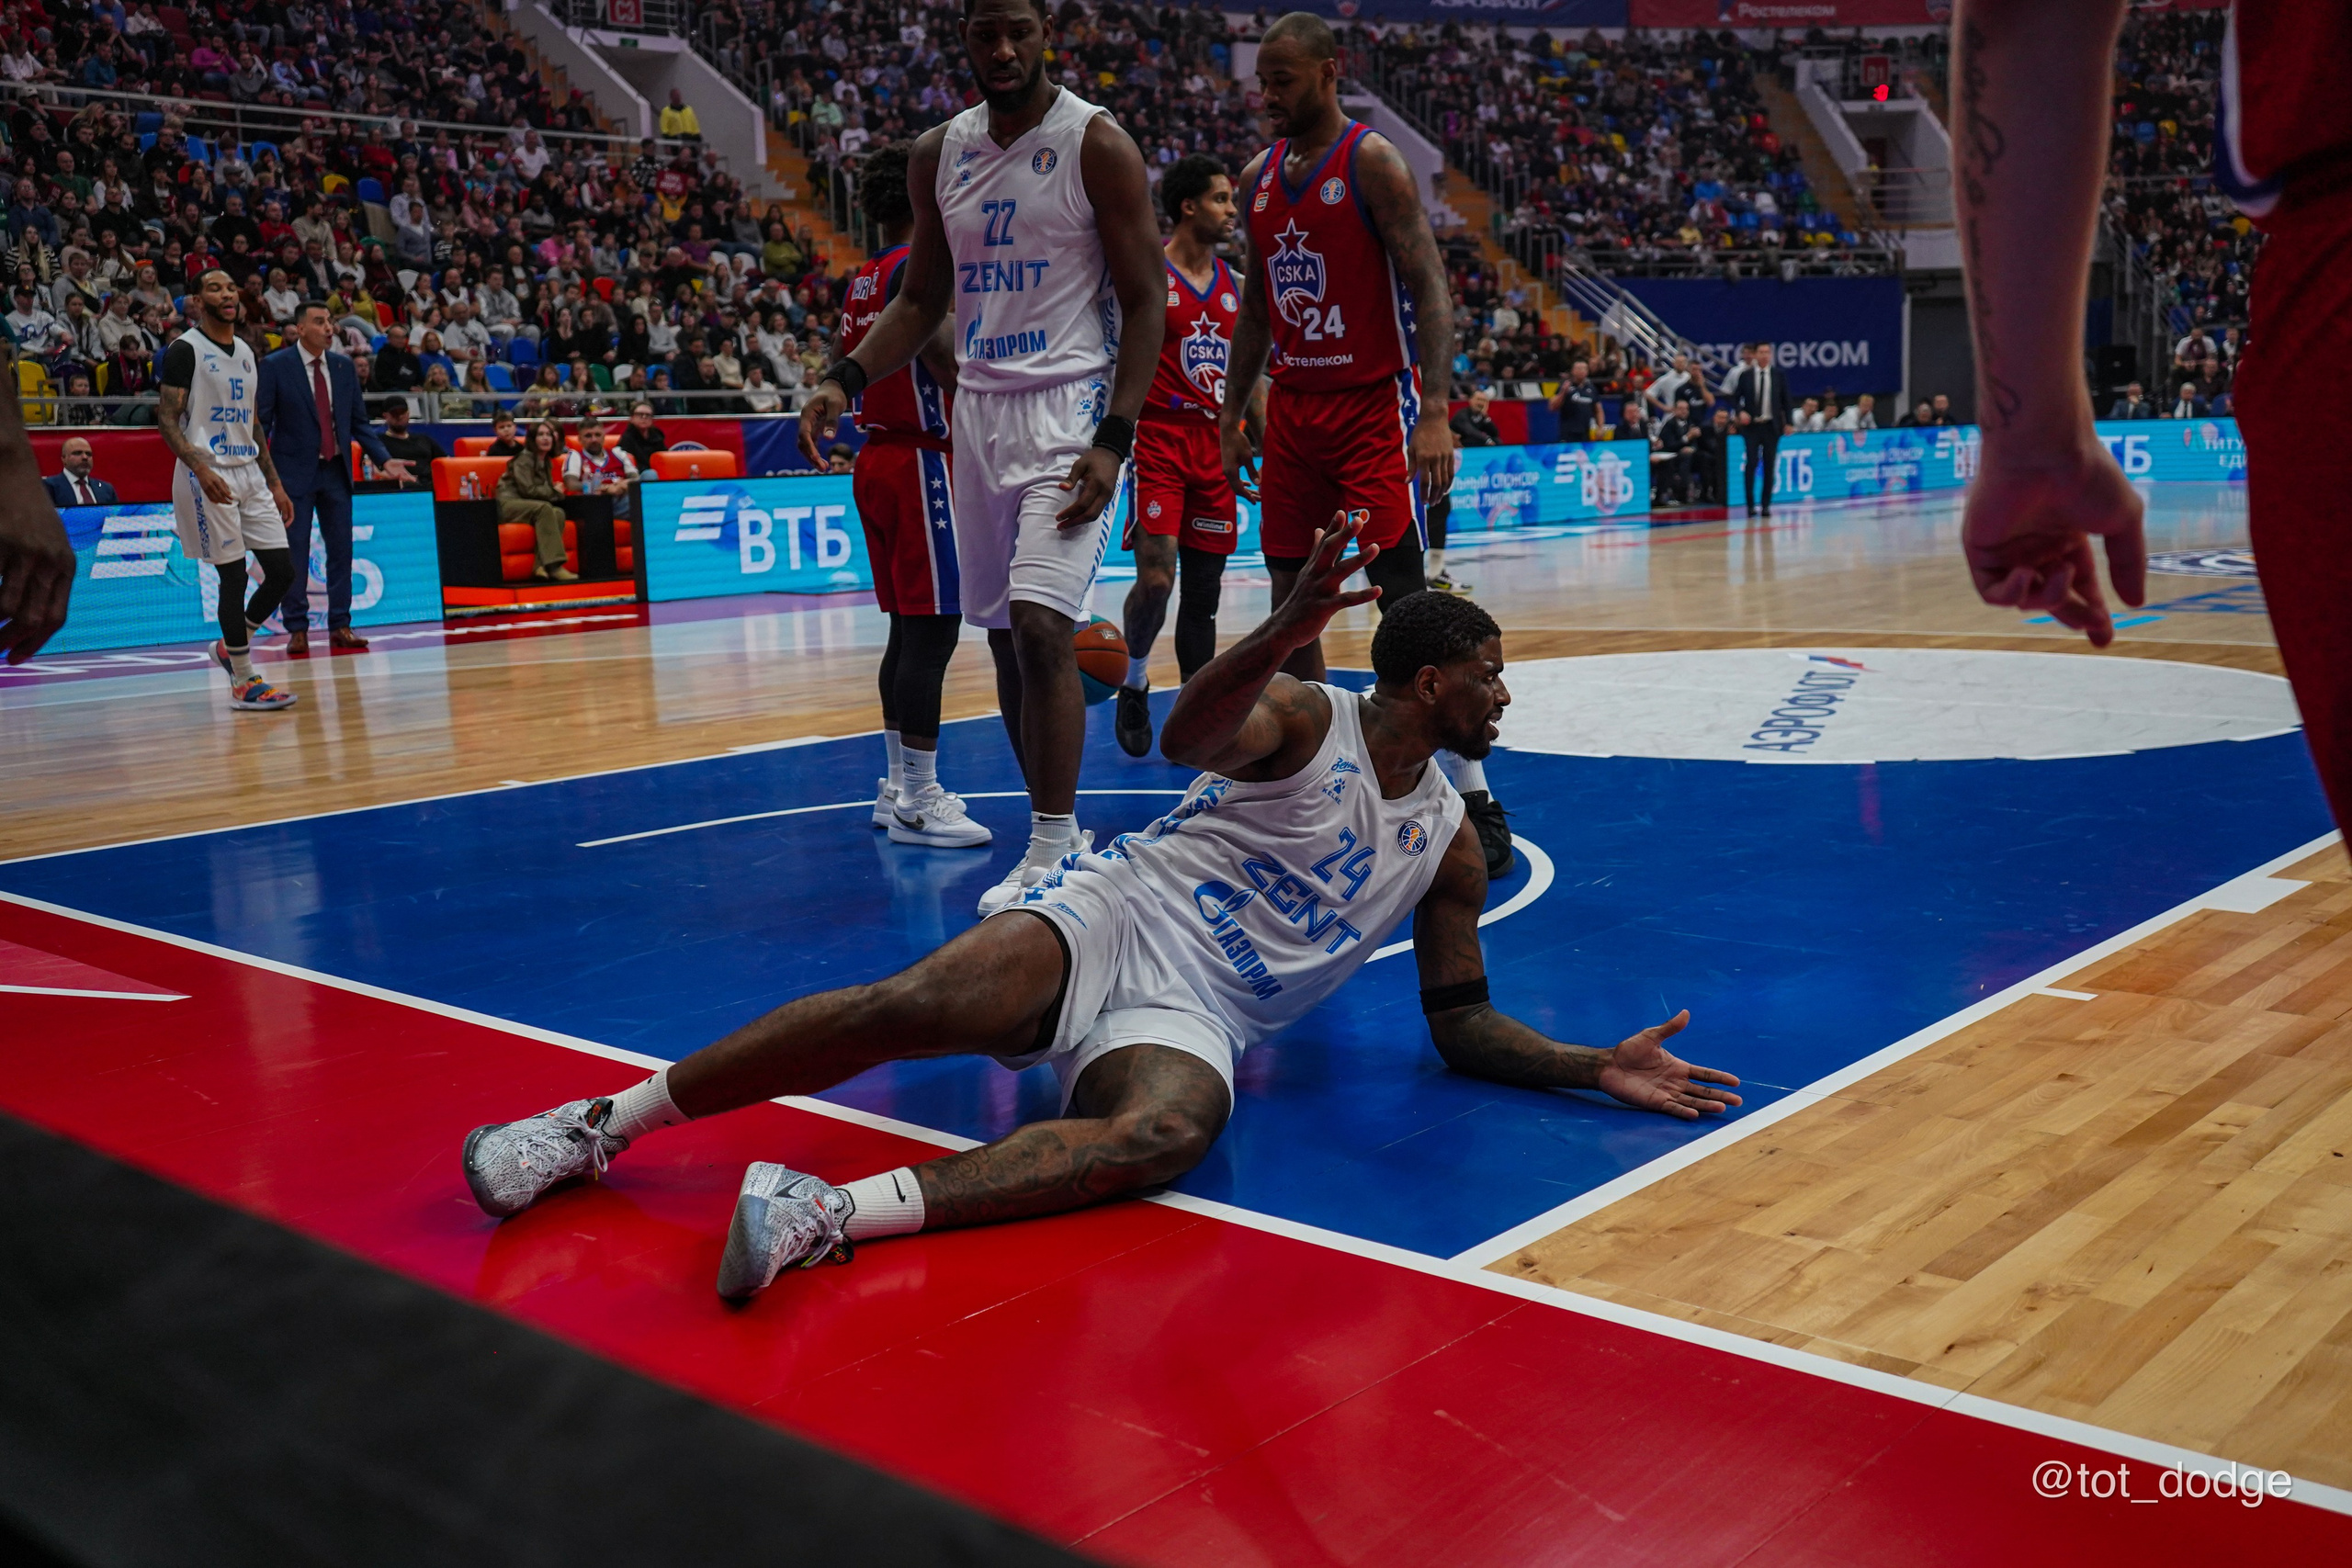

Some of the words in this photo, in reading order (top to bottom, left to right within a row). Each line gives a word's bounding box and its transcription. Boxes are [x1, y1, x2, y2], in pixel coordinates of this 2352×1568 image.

[981, 198, 1016, 246] 22
[958, 260, 1050, 293] ZENIT
[1276, 265, 1317, 283] CSKA
[1302, 304, 1346, 341] 24
[973, 330, 1047, 359] ГАЗПРОМ
[1188, 344, 1226, 360] CSKA
[228, 378, 243, 400] 15
[209, 406, 252, 423] ZENI
[2098, 434, 2153, 474] ТБ
[1581, 459, 1634, 506] ВТБ
[737, 503, 852, 574] ВТБ
[1743, 670, 1860, 753] АЭРОФЛОТ
[1321, 787, 1342, 805] KELME
[1310, 826, 1376, 901] 24
